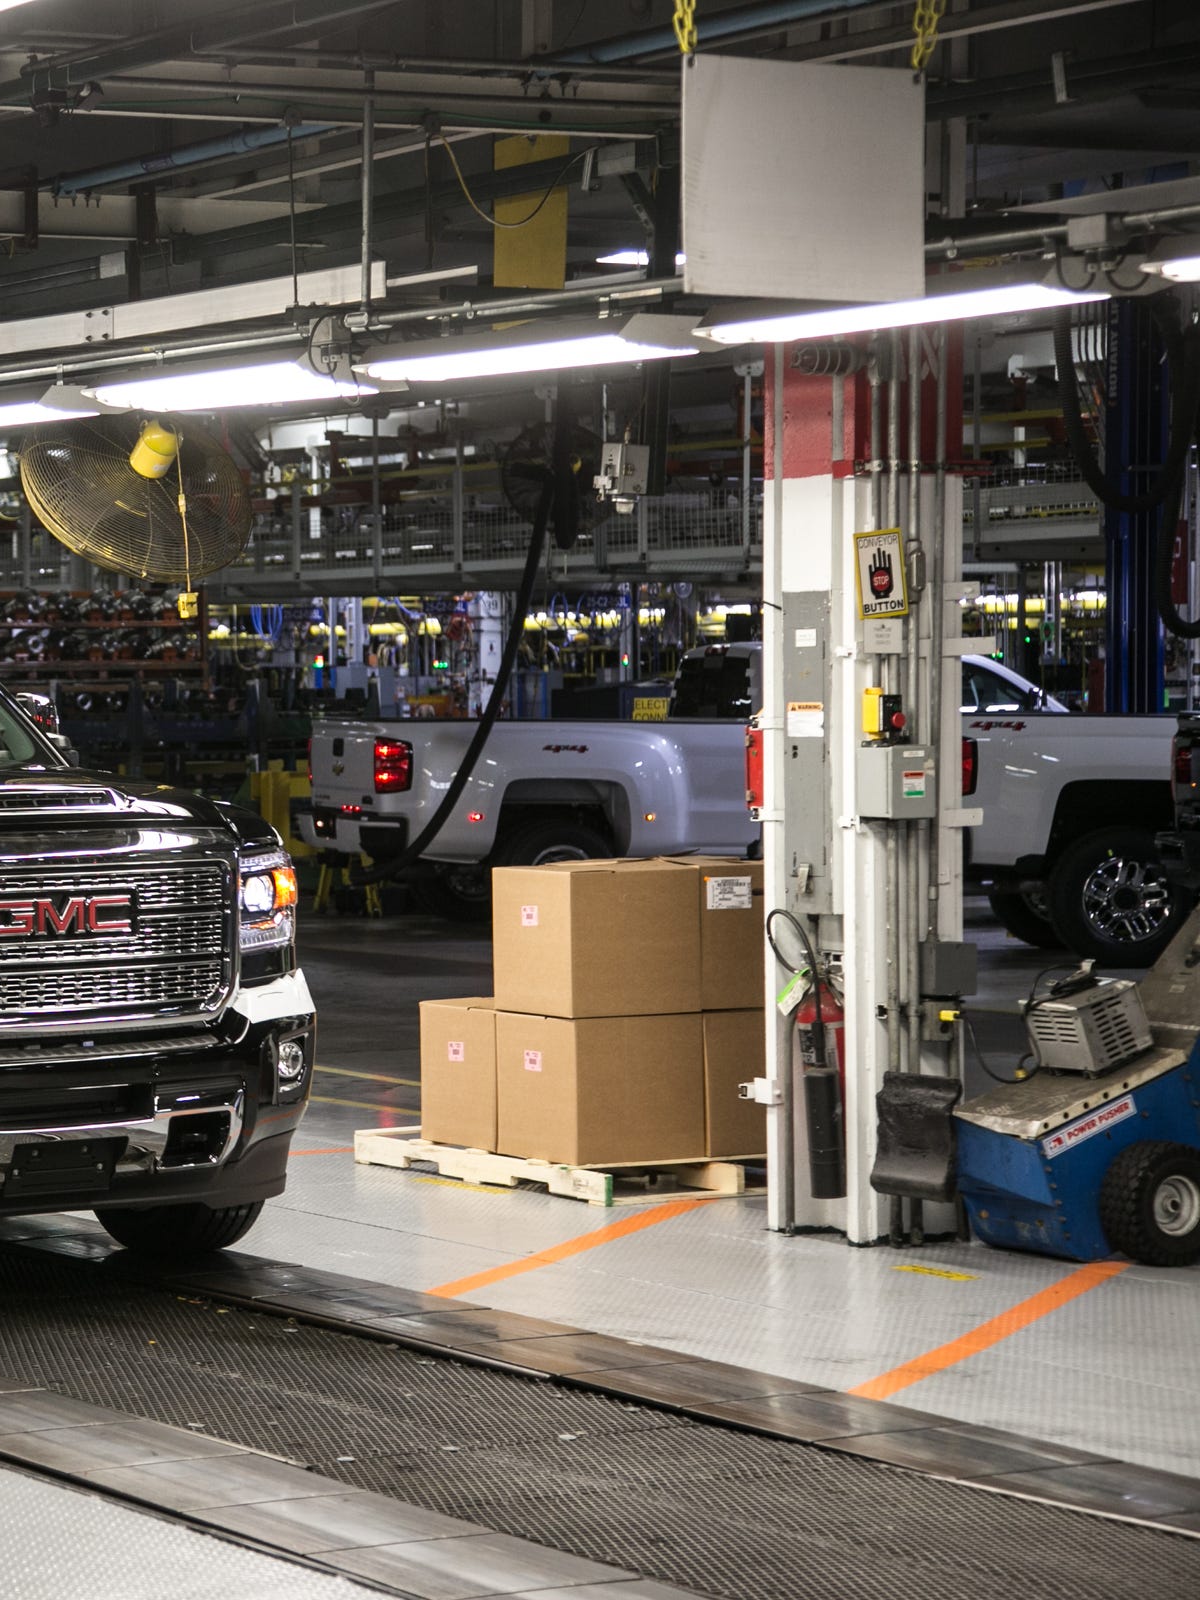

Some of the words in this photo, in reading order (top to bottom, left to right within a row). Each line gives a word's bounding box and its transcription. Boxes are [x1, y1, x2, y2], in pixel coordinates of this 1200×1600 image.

[858, 534, 898, 549] CONVEYOR
[873, 575, 889, 586] STOP
[864, 600, 904, 613] BUTTON
[1066, 1119, 1097, 1140] POWER
[1098, 1101, 1129, 1124] PUSHER
